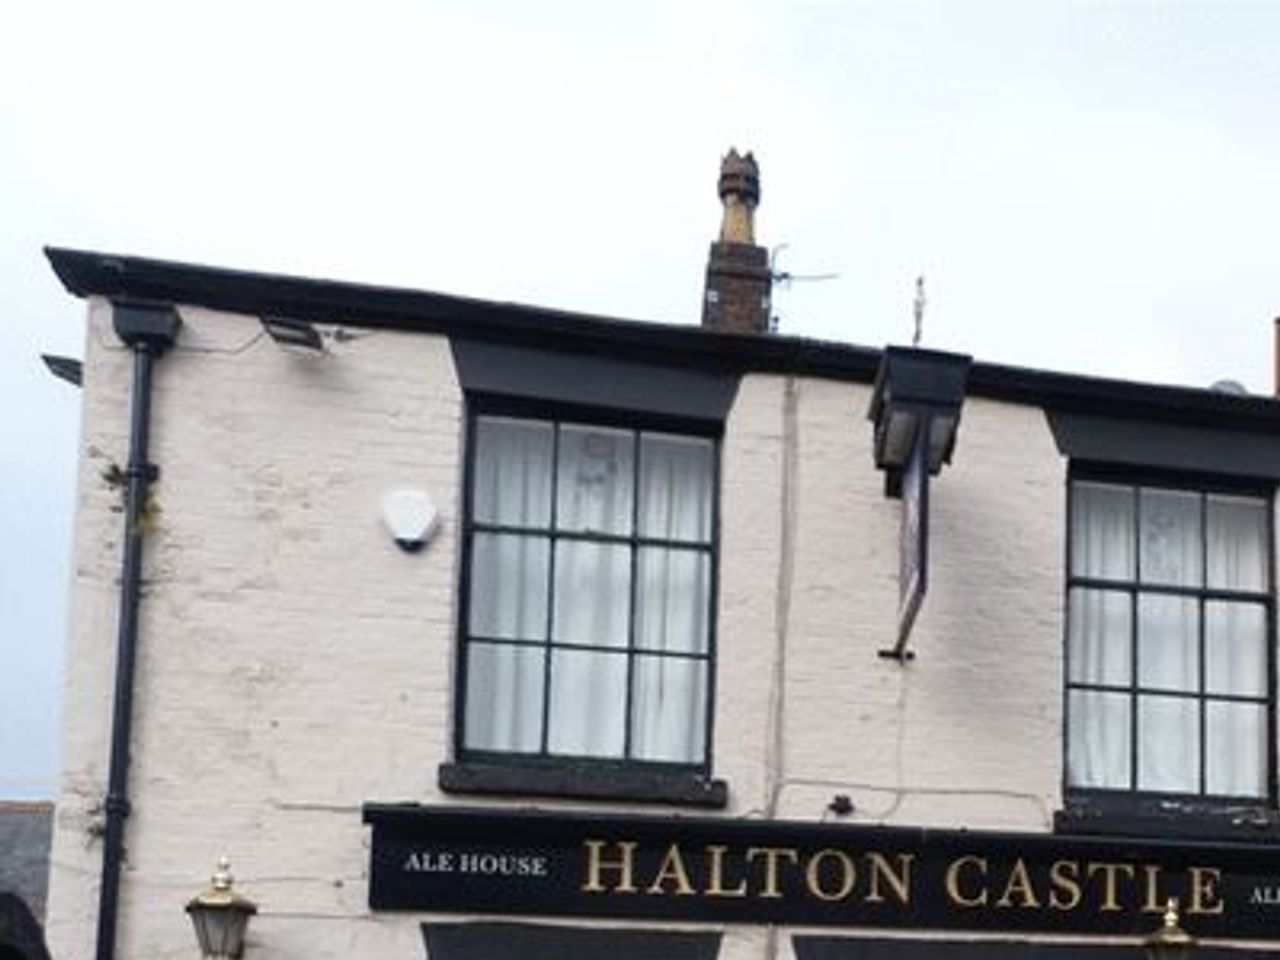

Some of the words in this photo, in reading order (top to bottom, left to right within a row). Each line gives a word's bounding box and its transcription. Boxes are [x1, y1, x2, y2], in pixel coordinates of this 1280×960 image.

[404, 853, 452, 872] ALE
[460, 854, 548, 876] HOUSE
[581, 839, 915, 903] HALTON
[946, 854, 1224, 914] CASTLE
